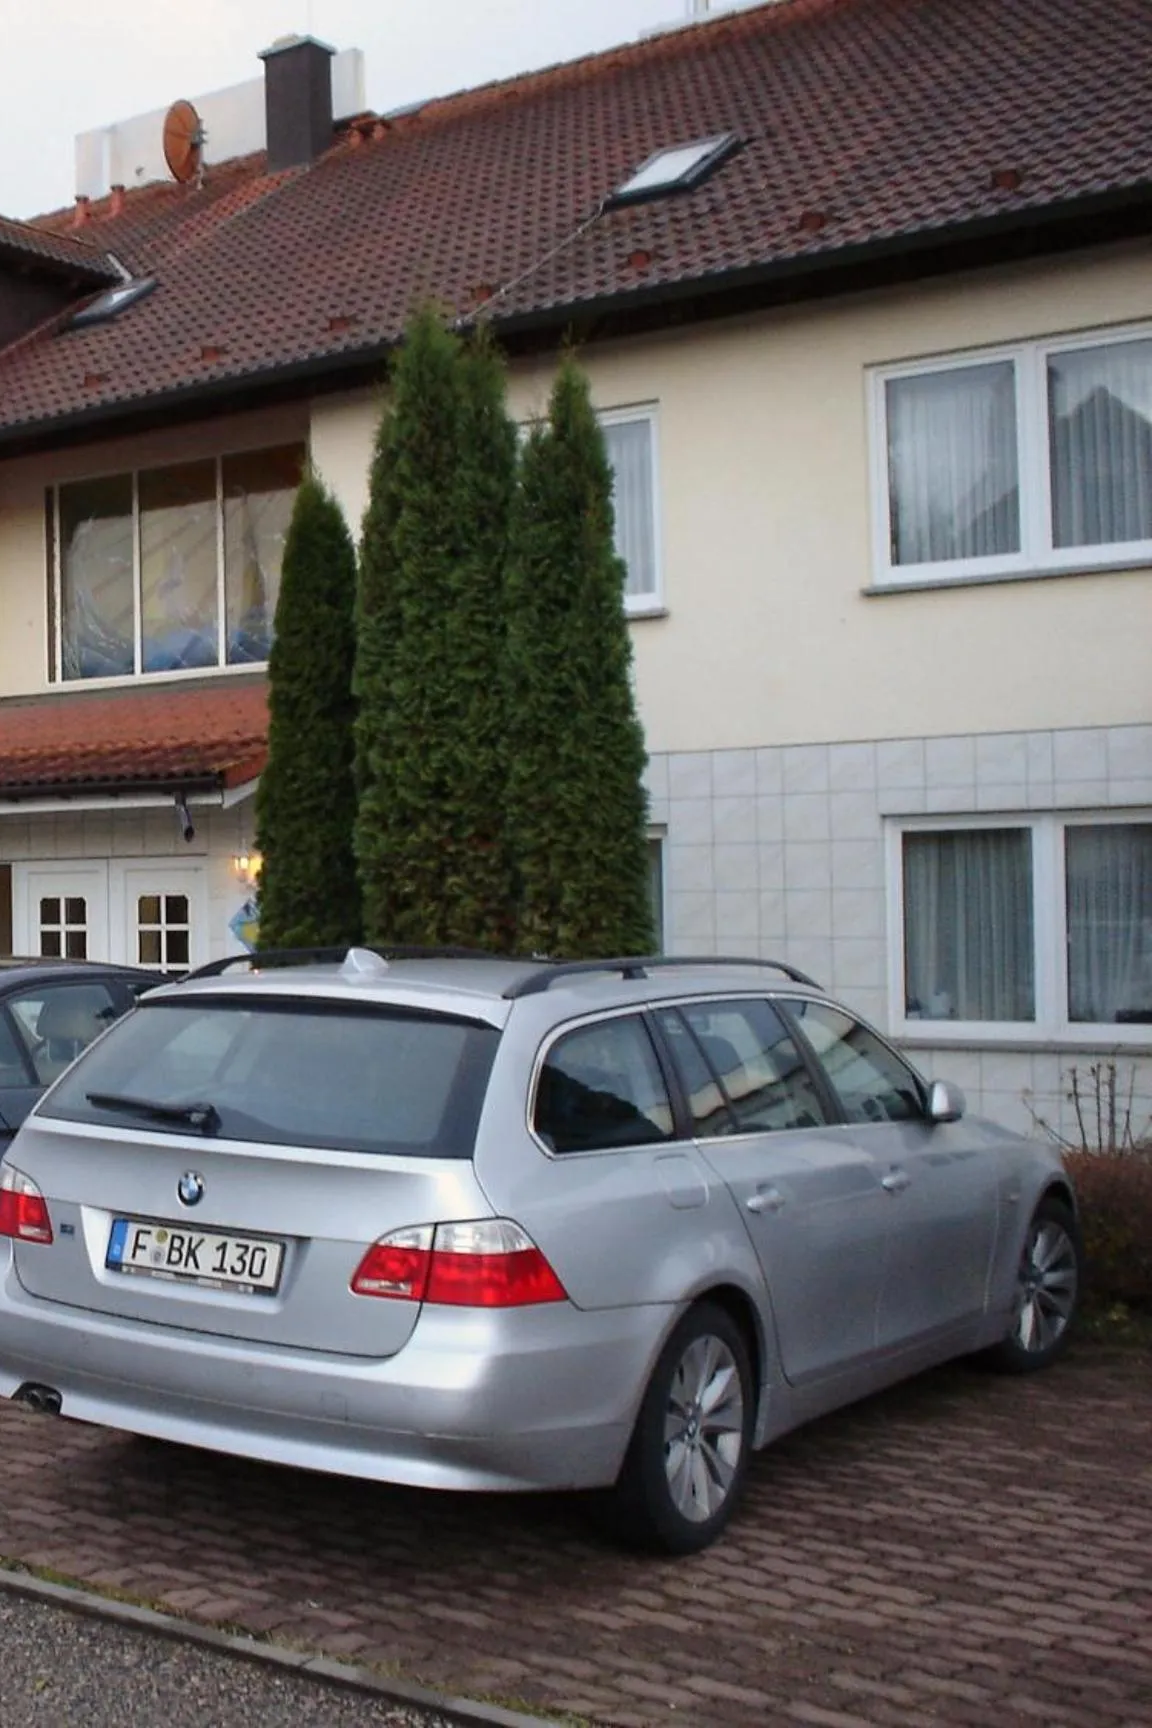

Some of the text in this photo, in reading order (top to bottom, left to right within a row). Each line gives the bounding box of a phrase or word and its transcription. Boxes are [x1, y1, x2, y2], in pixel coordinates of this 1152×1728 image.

[131, 1229, 266, 1279] F BK 130
